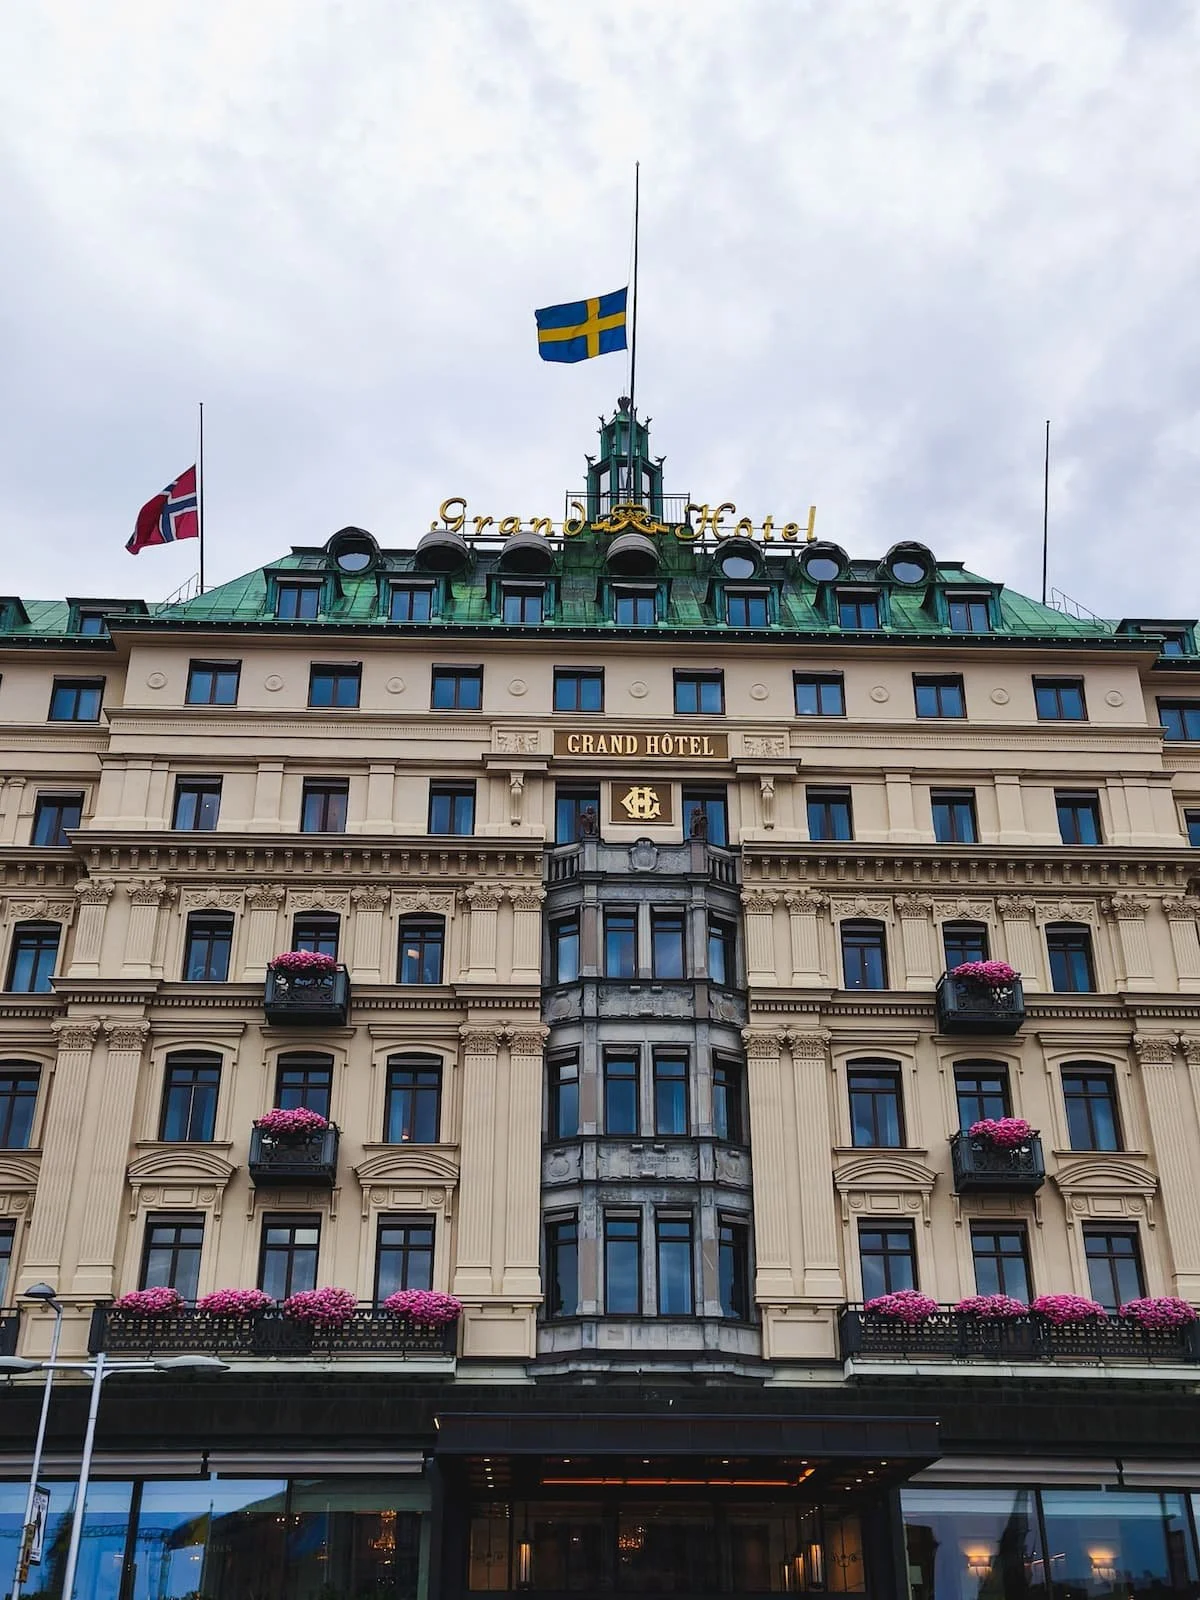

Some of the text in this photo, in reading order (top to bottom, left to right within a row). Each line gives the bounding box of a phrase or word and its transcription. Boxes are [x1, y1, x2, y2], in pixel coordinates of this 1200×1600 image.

[430, 497, 817, 542] Grand Hôtel
[567, 732, 714, 756] GRAND HÔTEL
